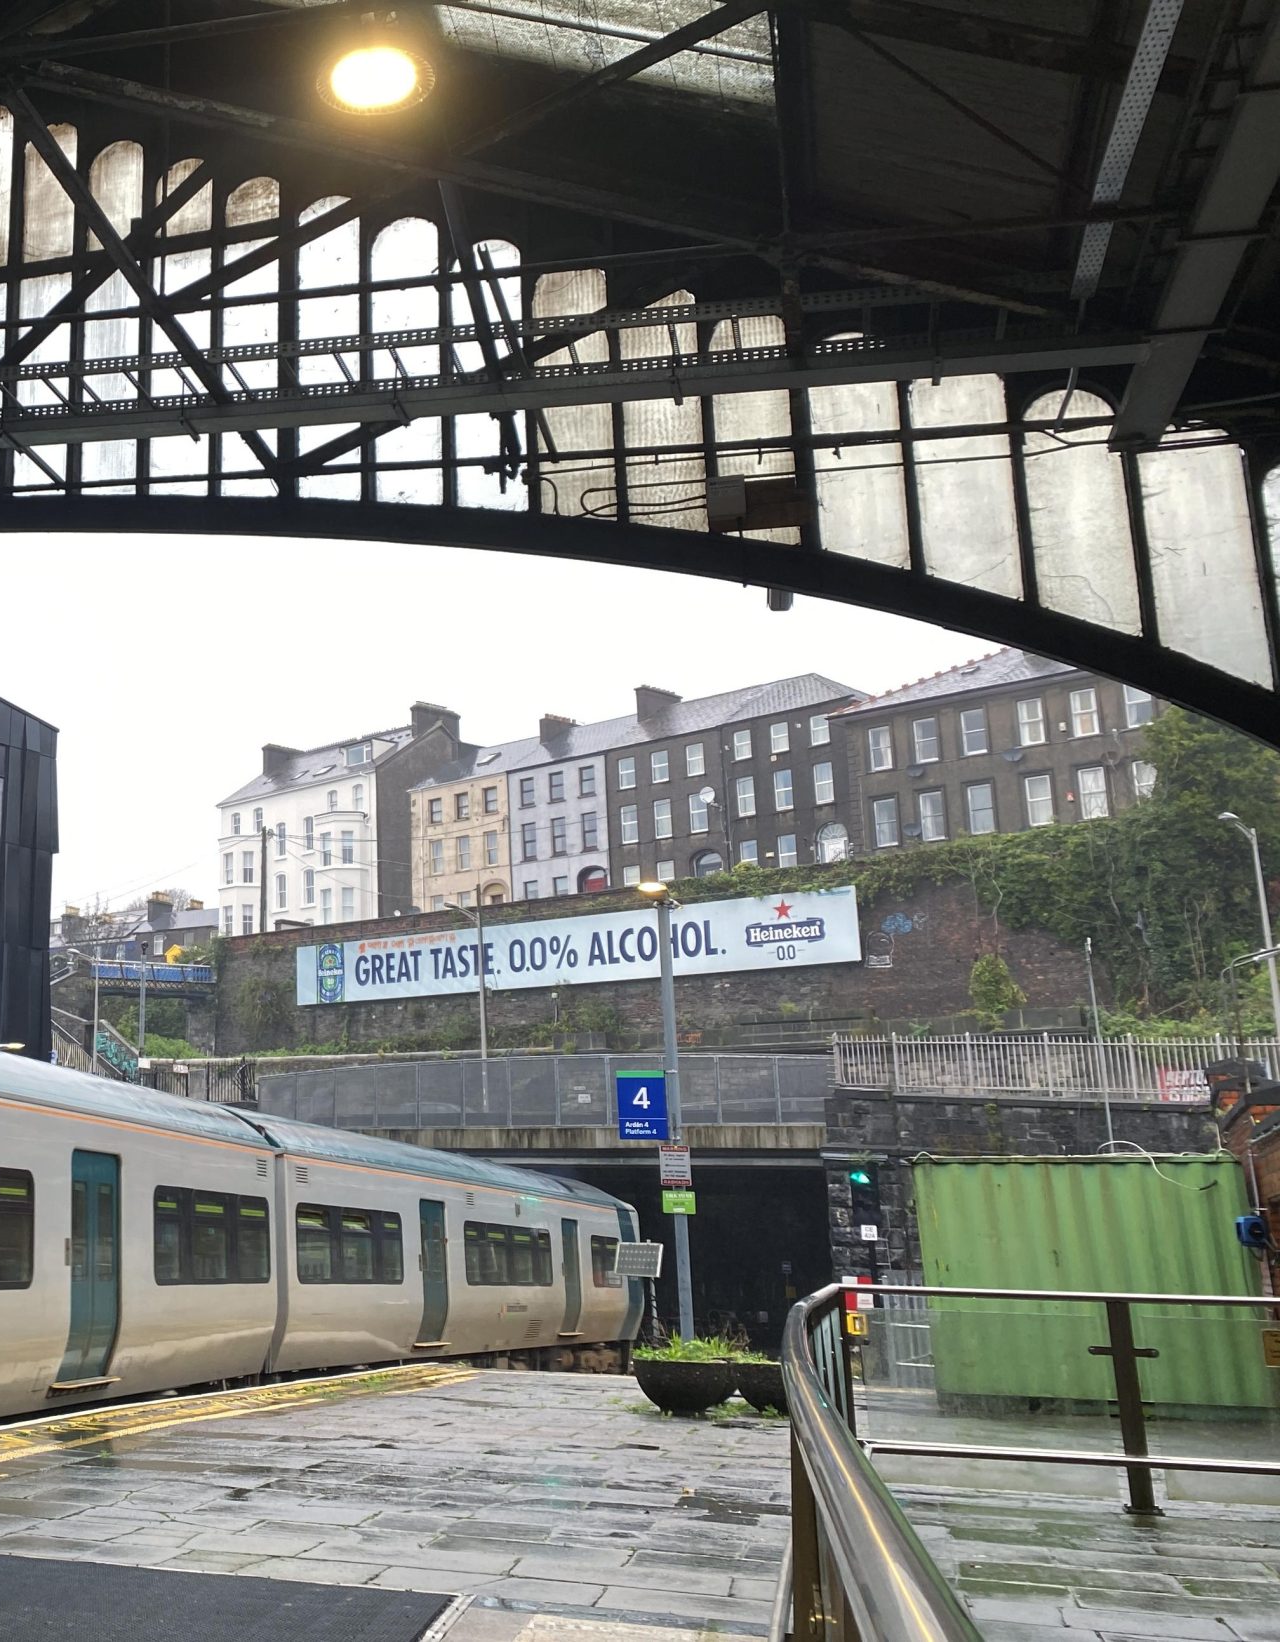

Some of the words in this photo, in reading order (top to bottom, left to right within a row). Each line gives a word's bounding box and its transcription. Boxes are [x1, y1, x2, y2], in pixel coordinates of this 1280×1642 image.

[749, 923, 821, 943] Heineken
[355, 950, 422, 986] GREAT
[429, 942, 501, 980] TASTE.
[509, 935, 579, 973] 0.0%
[776, 944, 796, 961] 0.0
[632, 1086, 651, 1110] 4
